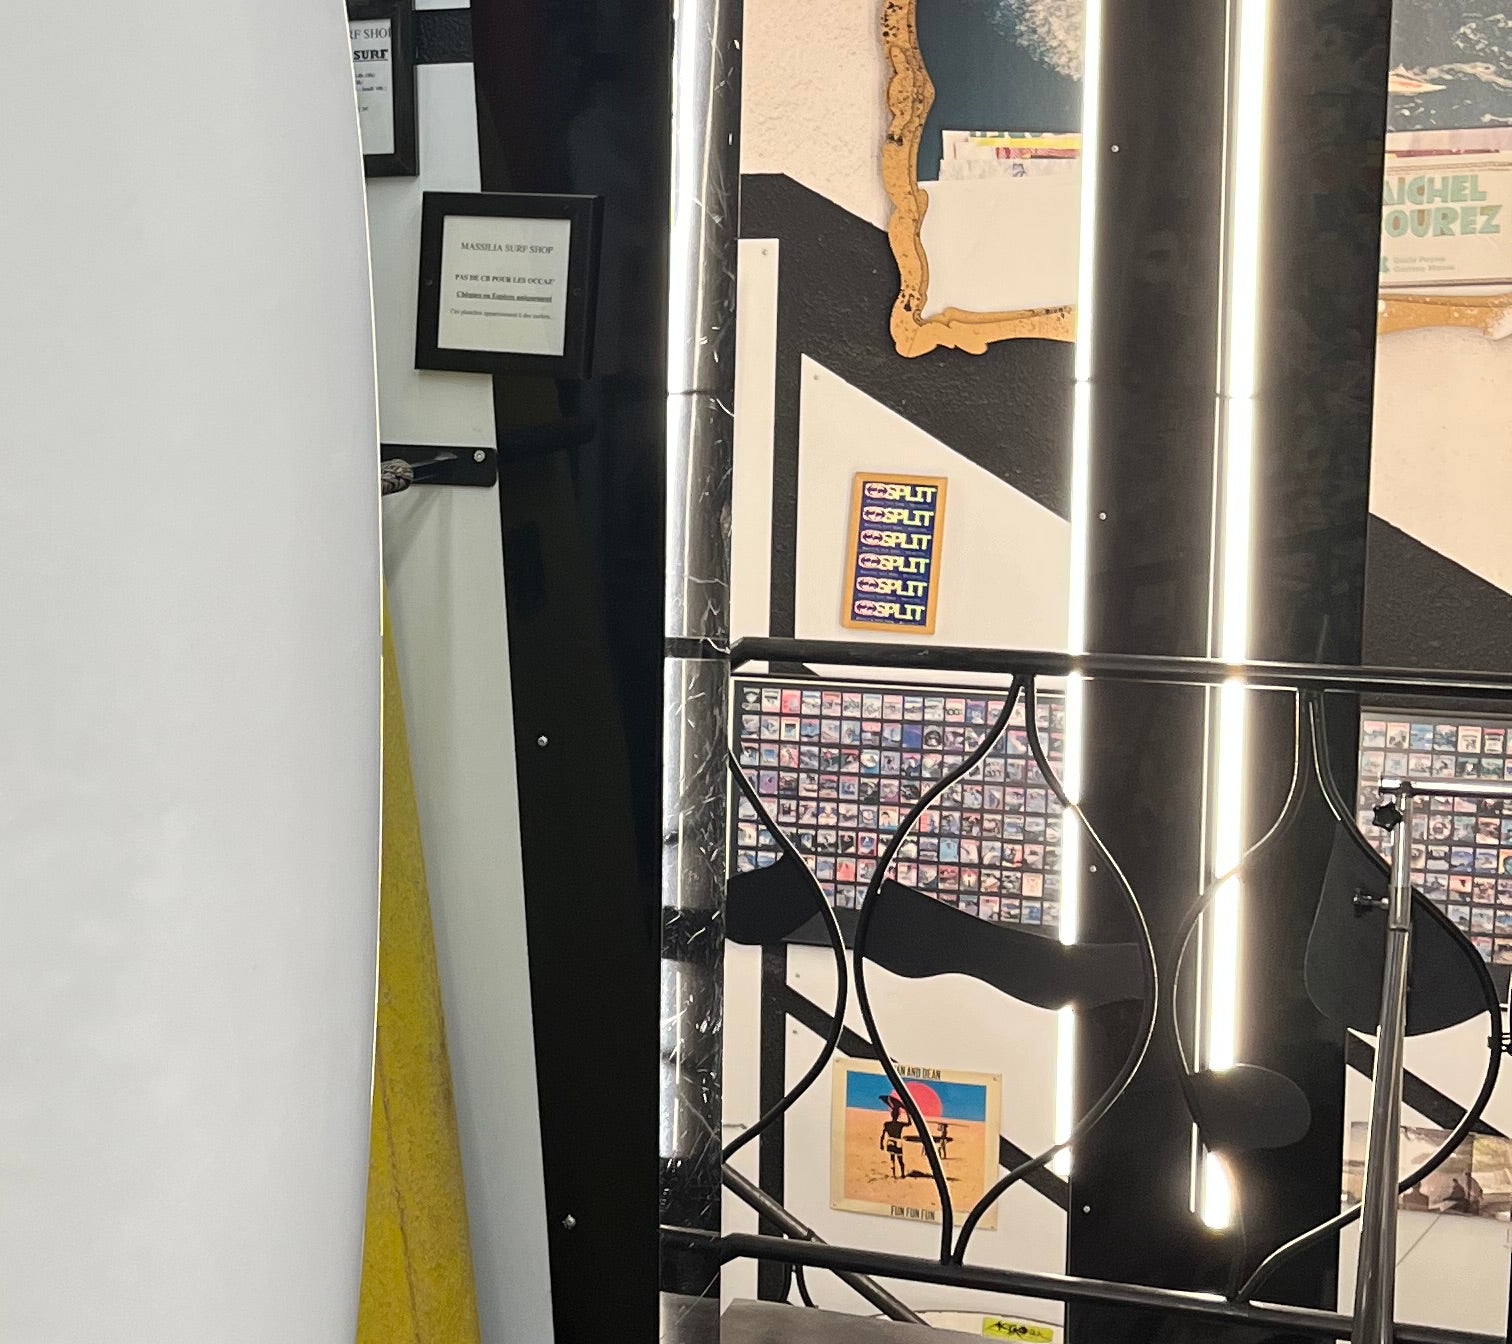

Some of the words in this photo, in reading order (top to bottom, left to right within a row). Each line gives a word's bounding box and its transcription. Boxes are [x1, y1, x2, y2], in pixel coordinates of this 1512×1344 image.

[1384, 204, 1503, 238] OUREZ
[461, 242, 503, 253] MASSILIA
[505, 244, 528, 254] SURF
[529, 245, 554, 255] SHOP
[455, 273, 469, 281] PAS
[470, 274, 479, 282] DE
[492, 276, 511, 284] POUR
[513, 277, 526, 285] LES
[906, 1066, 921, 1079] AND
[922, 1068, 942, 1081] DEAN
[891, 1205, 904, 1217] FUN
[906, 1207, 920, 1219] FUN
[921, 1208, 935, 1221] FUN
